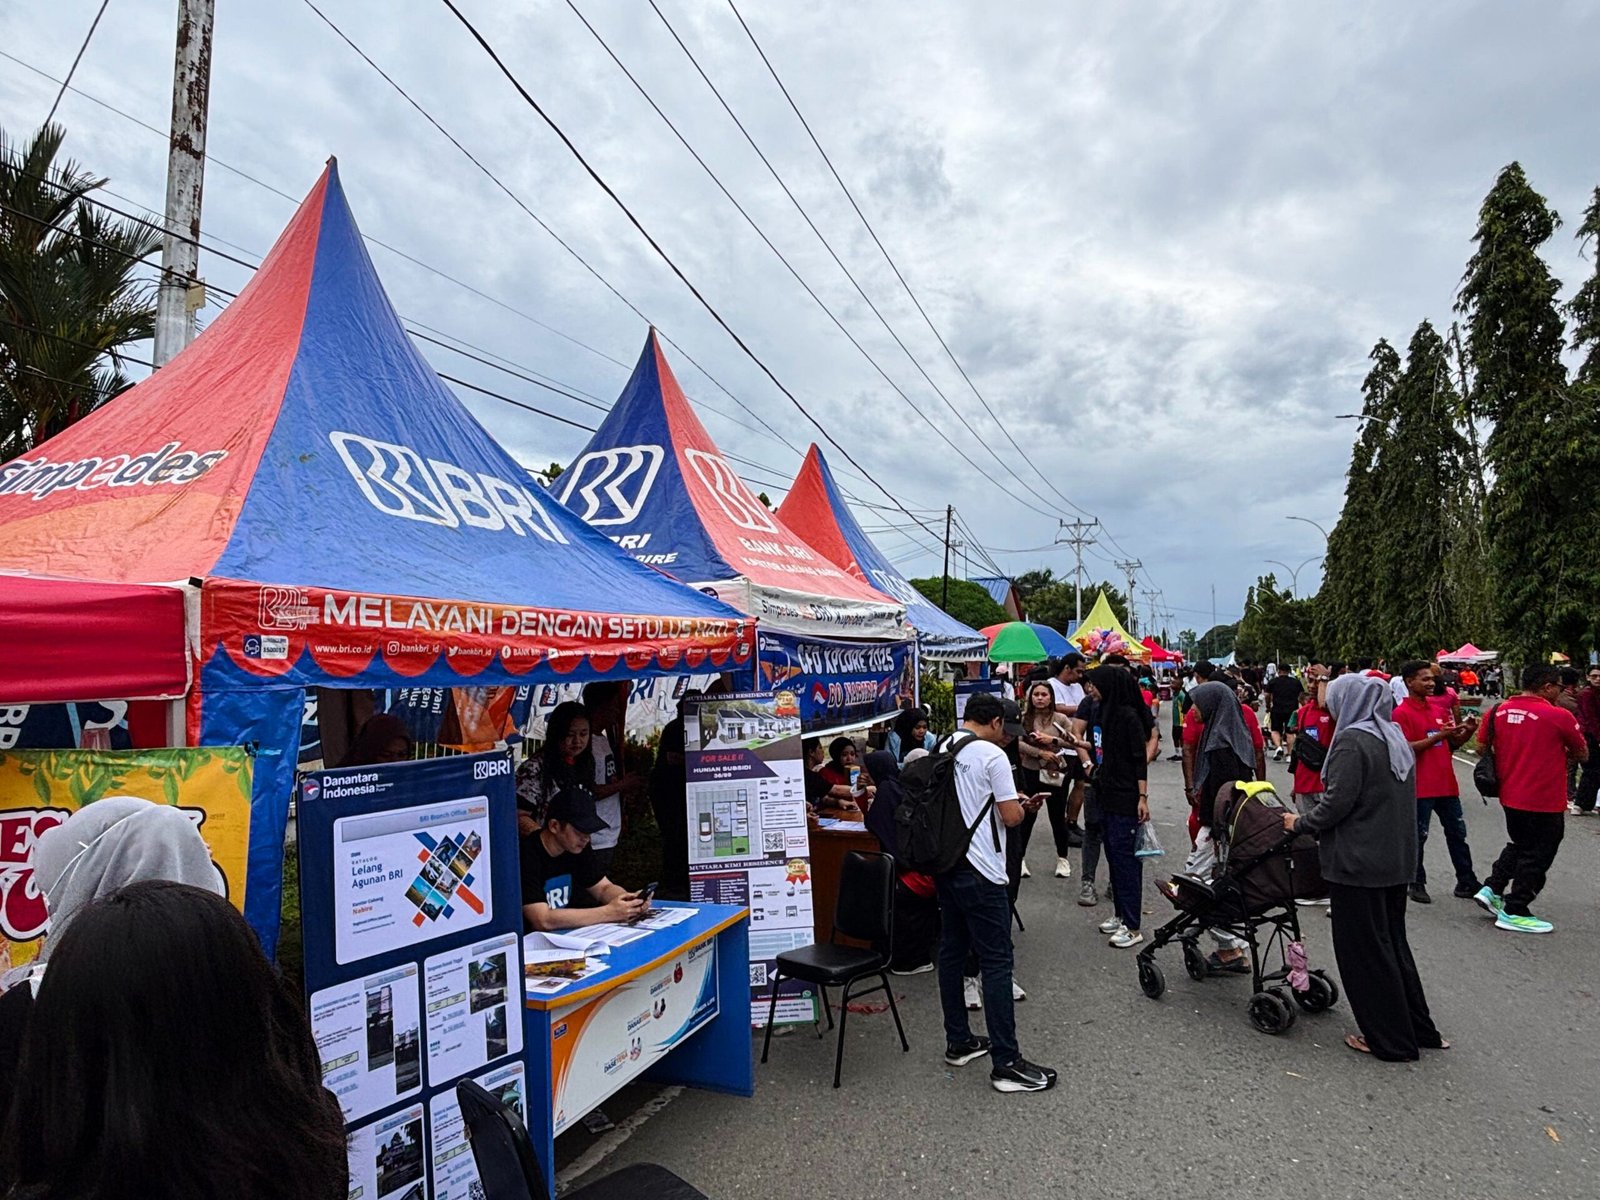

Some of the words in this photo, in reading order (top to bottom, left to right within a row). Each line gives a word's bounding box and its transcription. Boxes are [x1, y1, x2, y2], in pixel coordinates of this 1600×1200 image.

[427, 458, 570, 545] BRI
[738, 537, 789, 557] BANK
[783, 544, 814, 560] BRI
[323, 593, 493, 634] MELAYANI
[501, 610, 602, 638] DENGAN
[607, 618, 692, 640] SETULUS
[314, 644, 372, 654] www.bri.co.id
[400, 643, 440, 654] bankbri_id
[867, 647, 895, 673] 2025
[488, 760, 511, 776] BRI
[323, 773, 379, 788] Danantara
[322, 784, 375, 799] Indonesia
[352, 863, 383, 876] Lelang
[688, 864, 723, 872] MUTIARA
[743, 859, 785, 868] RESIDENCE
[351, 874, 386, 890] Agunan
[388, 868, 403, 881] BRI
